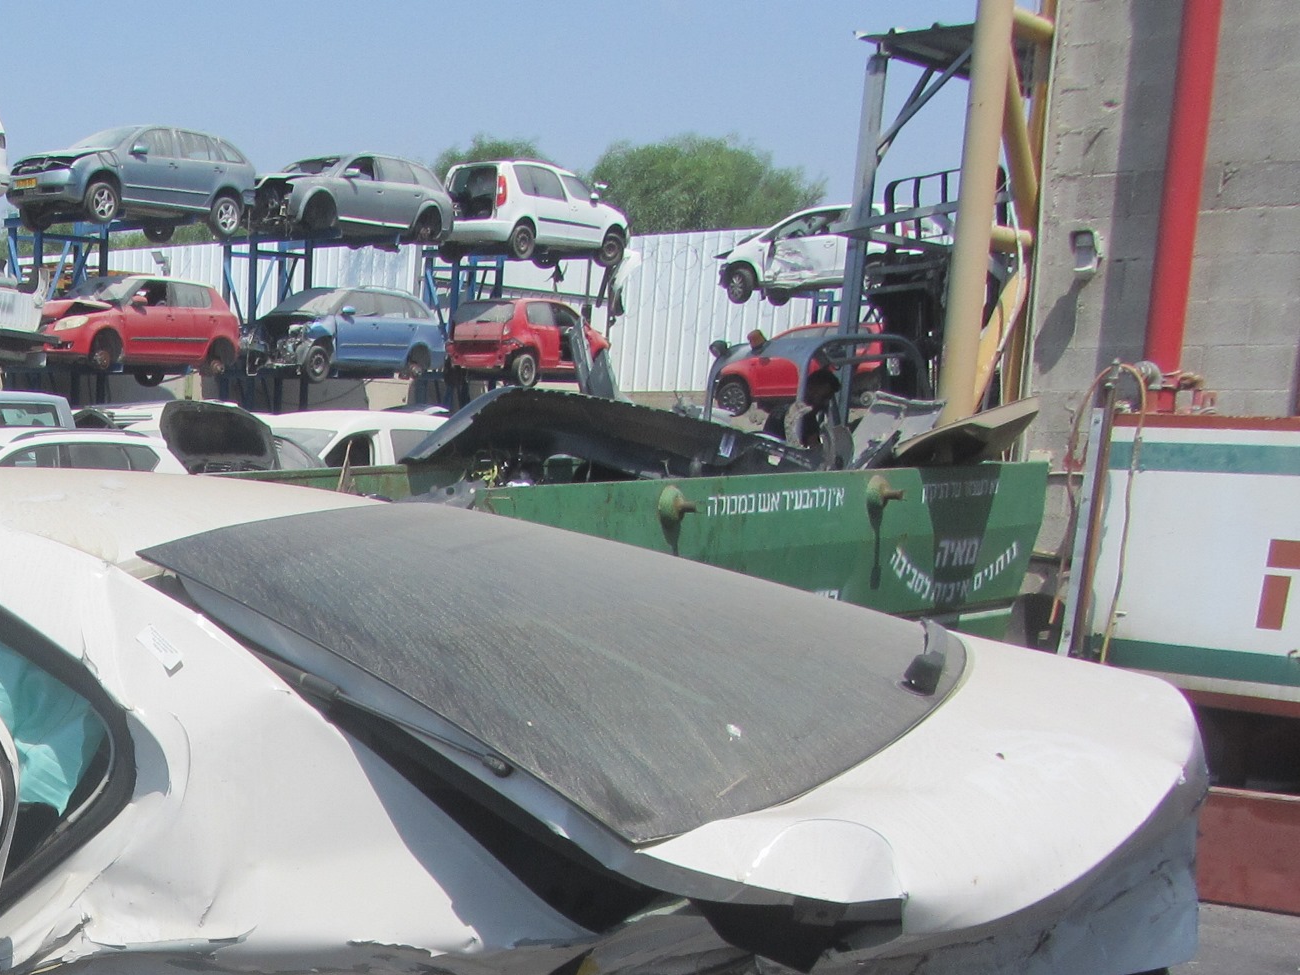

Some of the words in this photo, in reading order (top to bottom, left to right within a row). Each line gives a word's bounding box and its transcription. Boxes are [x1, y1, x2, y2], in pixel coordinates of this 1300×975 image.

[707, 492, 755, 516] במכולה
[758, 492, 780, 513] אש
[782, 486, 827, 511] להבעיר
[828, 487, 845, 511] אין
[935, 538, 981, 568] מאיה
